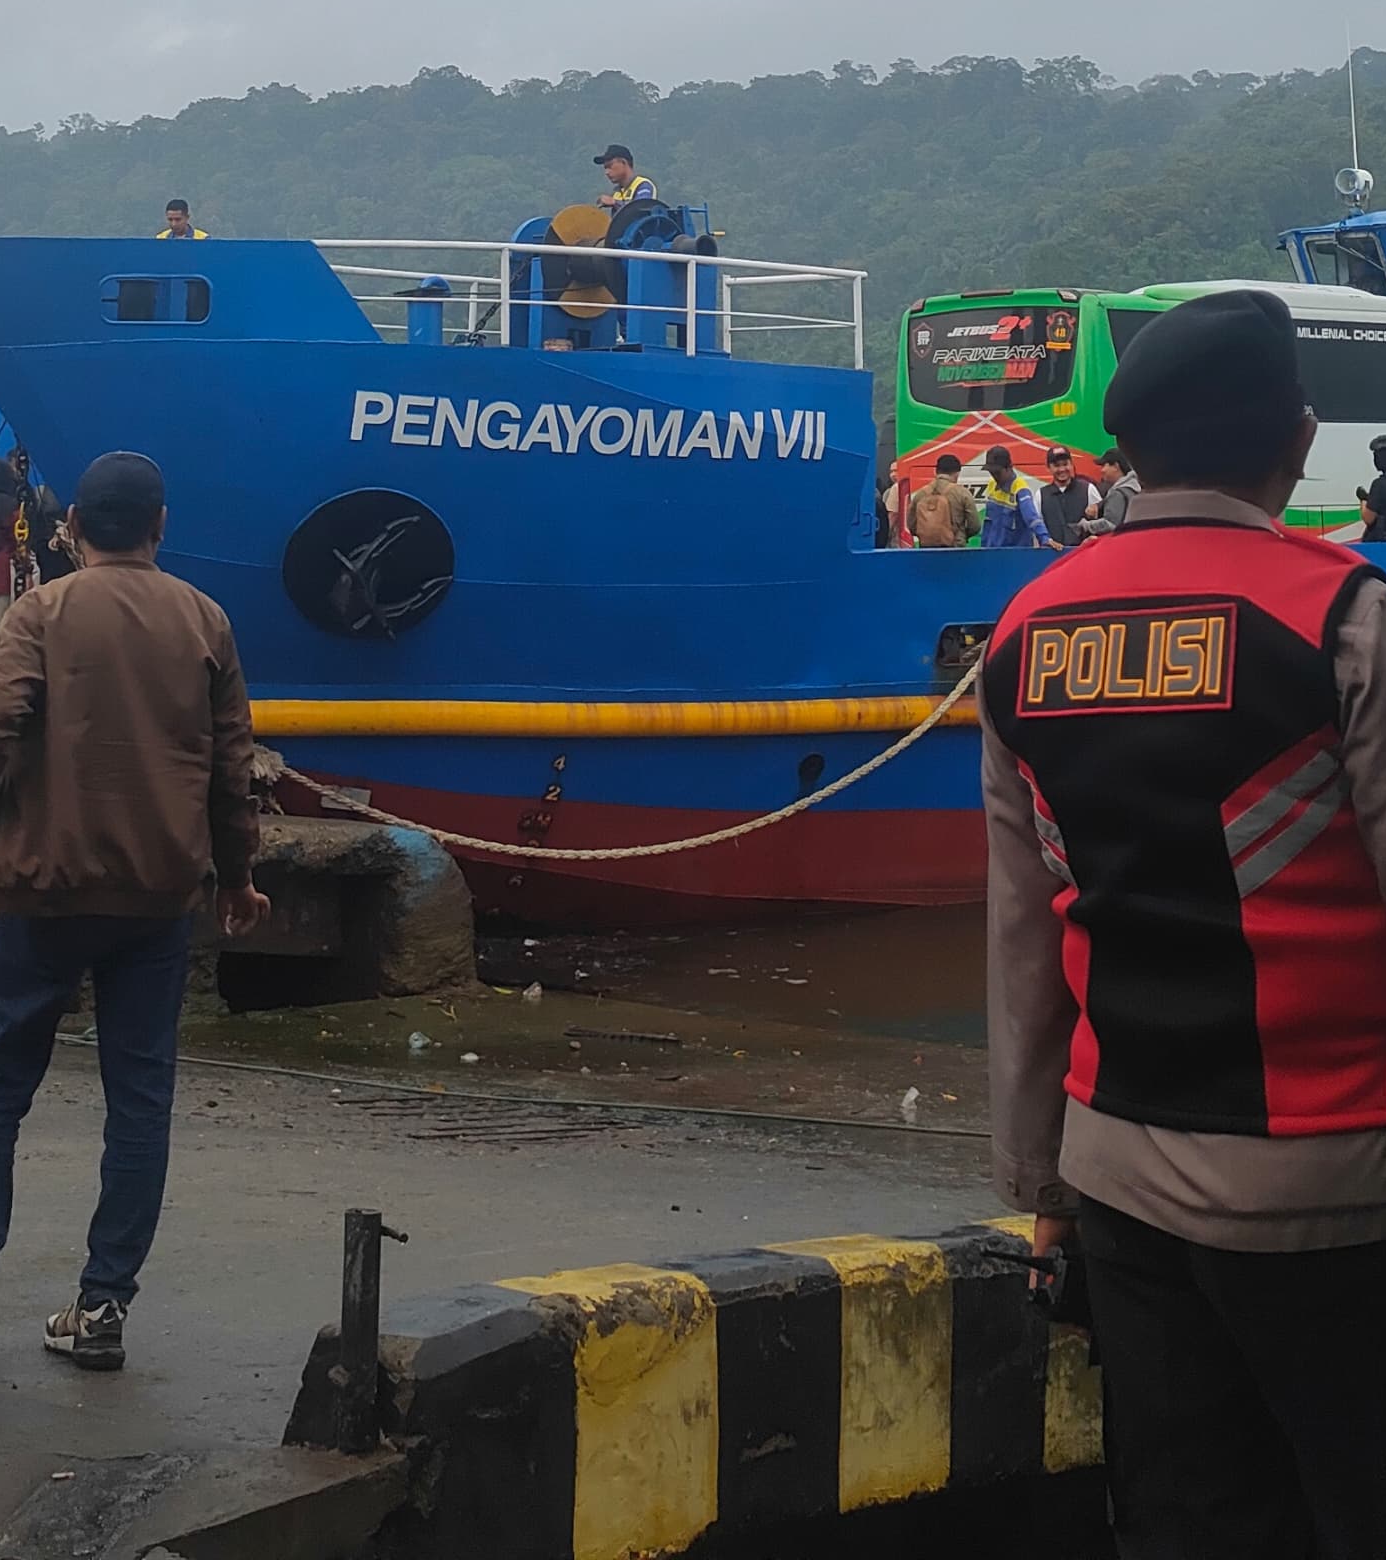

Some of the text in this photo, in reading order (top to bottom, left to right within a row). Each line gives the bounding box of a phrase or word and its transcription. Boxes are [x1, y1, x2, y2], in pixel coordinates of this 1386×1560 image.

[947, 324, 999, 337] JETBUS
[1296, 326, 1352, 340] MILLENIAL
[933, 344, 1047, 364] PARIWISATA
[350, 389, 827, 461] PENGAYOMAN VII
[1026, 615, 1226, 704] POLISI
[554, 756, 565, 770] 4
[546, 786, 561, 800] 2
